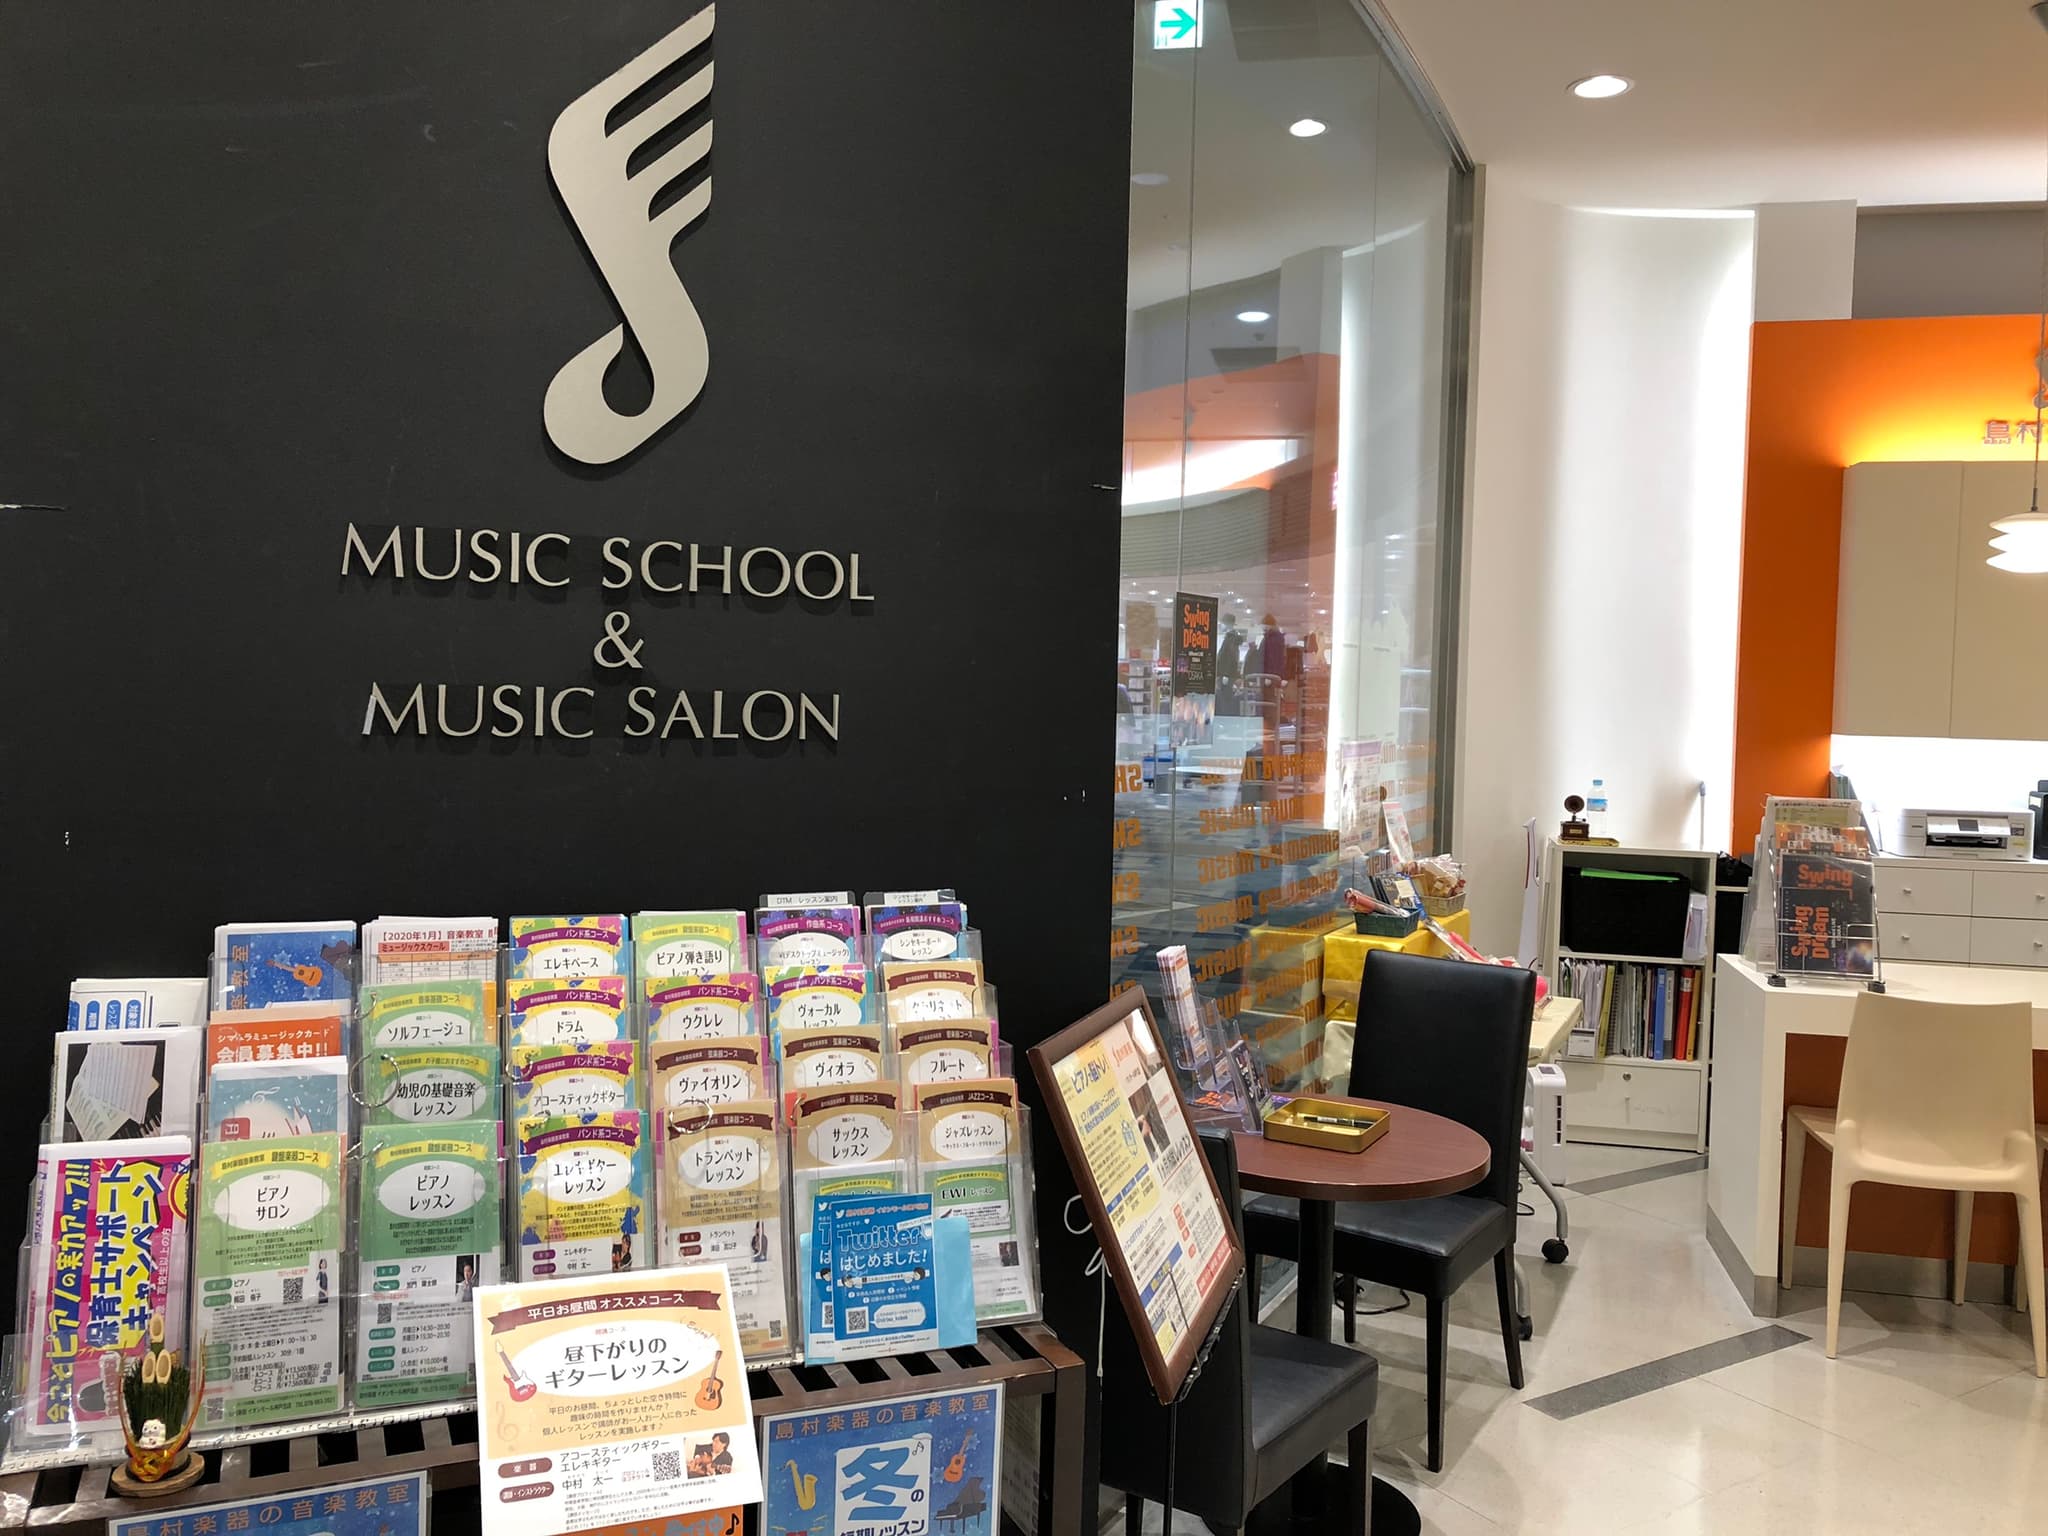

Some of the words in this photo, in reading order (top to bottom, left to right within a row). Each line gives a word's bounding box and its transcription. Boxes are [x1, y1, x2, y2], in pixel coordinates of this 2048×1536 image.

[341, 522, 571, 588] MUSIC
[601, 537, 875, 601] SCHOOL
[1183, 603, 1210, 632] Swing
[593, 611, 645, 669] &
[1183, 628, 1209, 649] Dream
[361, 681, 595, 739] MUSIC
[623, 686, 840, 741] SALON
[1797, 863, 1854, 888] Swing
[446, 929, 484, 940] 音楽教室
[564, 928, 609, 940] バンド系コース
[1790, 904, 1814, 958] Swing
[1811, 905, 1830, 959] Dream
[381, 943, 446, 952] ミュージックスクール
[543, 956, 599, 970] エレキベース
[656, 950, 723, 967] ピアノ弾き語り
[564, 990, 611, 1003] バンド系コース
[798, 1002, 842, 1017] ヴォーカル
[556, 1020, 584, 1034] ドラム
[682, 1014, 723, 1030] ウクレレ
[388, 1021, 464, 1042] ソルフェージュ
[815, 1060, 855, 1077] ヴィオラ
[930, 1059, 966, 1074] フルート
[397, 1082, 476, 1099] 幼児の基礎音楽
[679, 1073, 741, 1091] ヴァイオリン
[534, 1088, 625, 1107] アコースティックギター
[413, 1101, 457, 1116] レッスン
[577, 1127, 626, 1140] バンド系コース
[832, 1125, 870, 1141] サックス
[945, 1125, 995, 1140] ジャズレッスン
[695, 1147, 753, 1166] トランペット
[832, 1143, 869, 1159] レッスン
[417, 1174, 450, 1192] ピアノ
[705, 1167, 745, 1184] レッスン
[257, 1186, 290, 1203] ピアノ
[564, 1178, 607, 1195] レッスン
[941, 1187, 967, 1200] EWI
[410, 1193, 456, 1211] レッスン
[255, 1203, 290, 1222] サロン
[836, 1225, 921, 1252] Twitter
[86, 1160, 131, 1348] 保育士サポート
[121, 1172, 166, 1331] キャンペーン
[840, 1248, 928, 1271] はじめました!
[411, 1264, 427, 1274] ピアノ
[46, 1162, 92, 1423] 今こそピアノの実力アップ!!
[233, 1279, 250, 1288] ピアノ
[527, 1299, 598, 1320] 平日お昼間
[599, 1292, 686, 1310] オススメコース
[564, 1336, 667, 1366] 昼下がりの
[545, 1356, 690, 1389] ギターレッスン
[549, 1391, 688, 1416] 平日のお昼間、ちょっとした空き時間に
[775, 1393, 990, 1441] 島村楽器の音楽教室
[560, 1440, 671, 1463] アコースティックギター
[560, 1457, 622, 1473] エレキギター
[562, 1478, 583, 1491] 中村
[592, 1475, 614, 1488] 太一
[840, 1446, 920, 1521] 冬
[910, 1488, 925, 1503] の
[127, 1482, 411, 1536] 島村楽器の音楽教室
